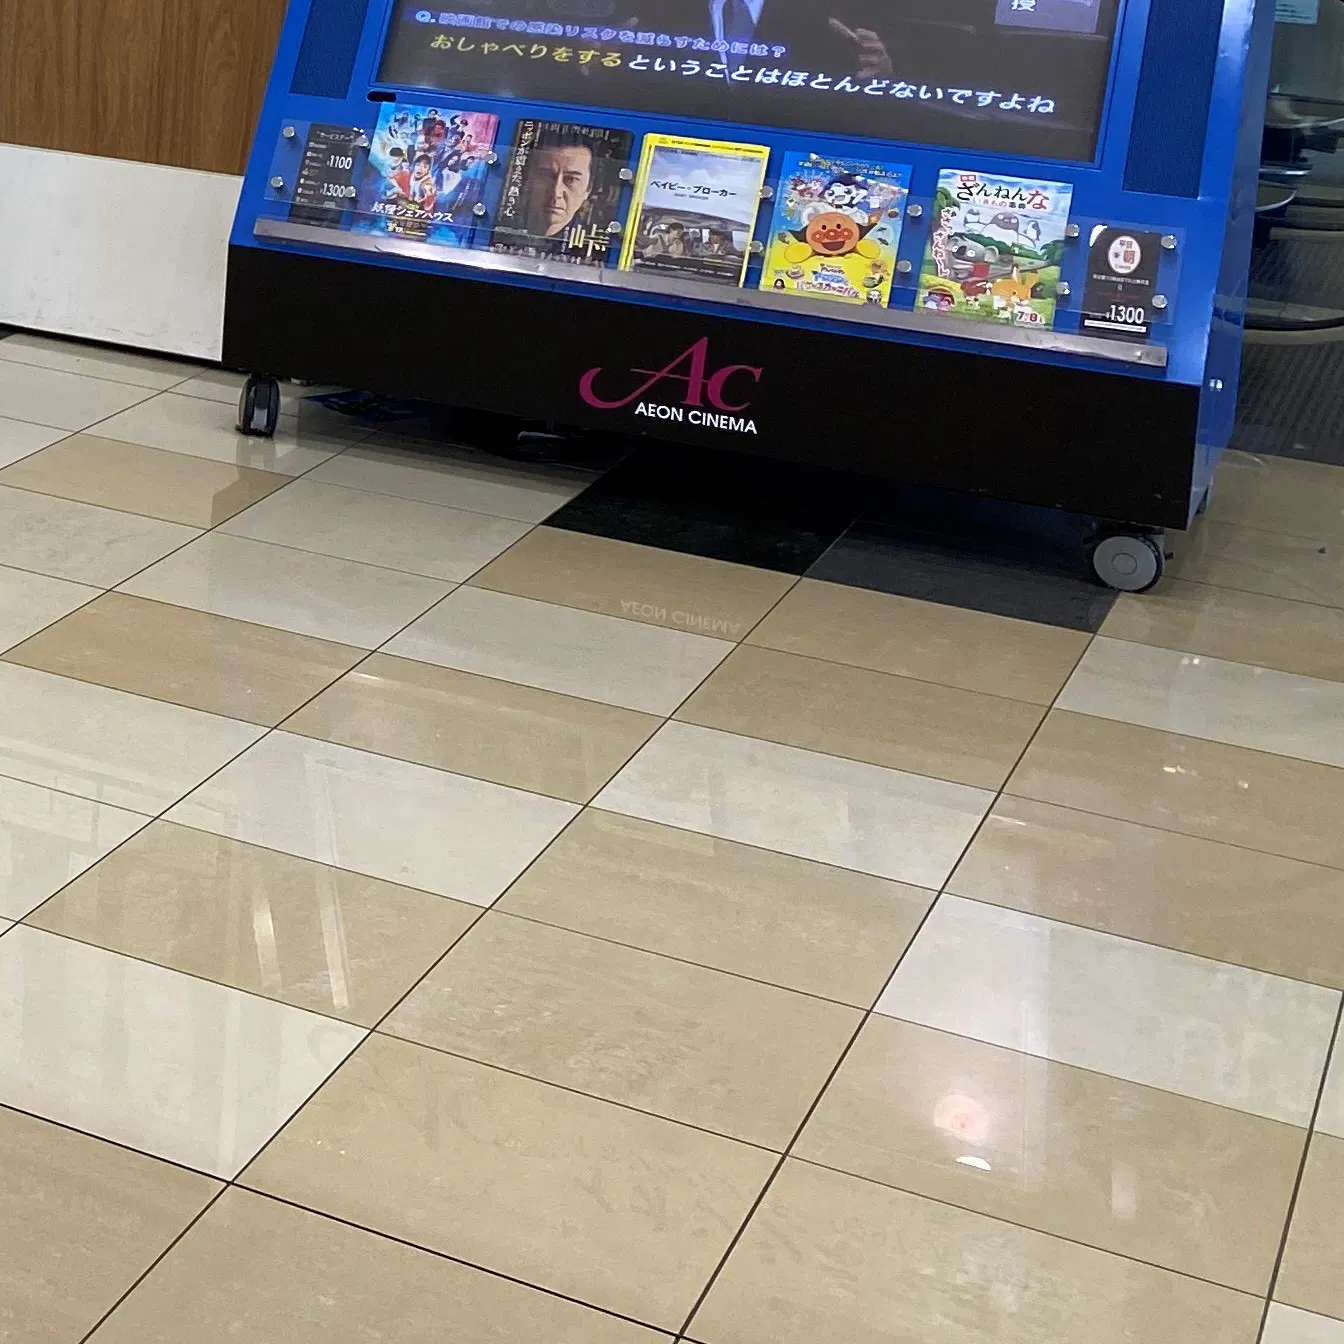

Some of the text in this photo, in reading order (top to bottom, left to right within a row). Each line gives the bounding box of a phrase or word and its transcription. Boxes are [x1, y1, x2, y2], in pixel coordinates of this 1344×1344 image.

[650, 179, 738, 198] ベイビー・ブローカー
[956, 182, 1050, 211] ざんねんな
[370, 201, 455, 223] 妖怪シェアハウス
[568, 223, 611, 258] 峠
[634, 401, 758, 435] AEON CINEMA
